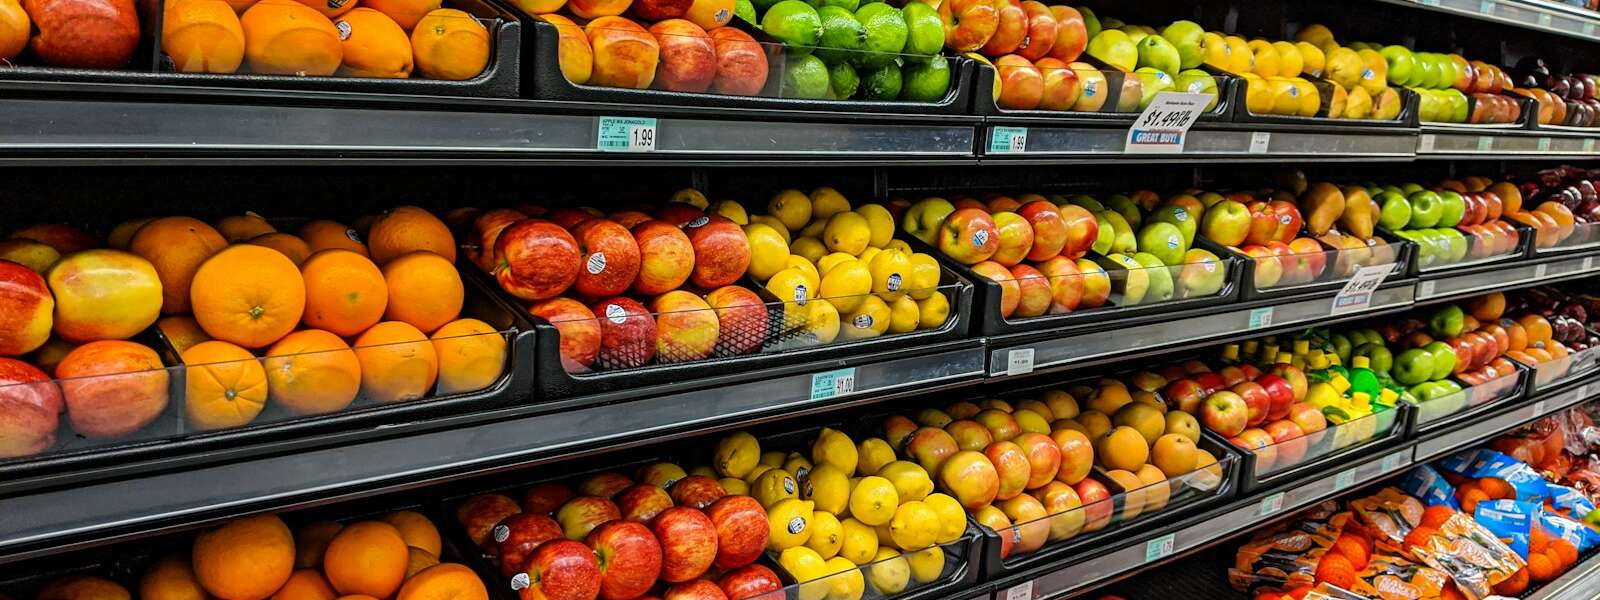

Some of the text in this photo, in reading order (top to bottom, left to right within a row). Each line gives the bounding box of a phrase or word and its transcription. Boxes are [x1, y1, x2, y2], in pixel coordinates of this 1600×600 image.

[634, 128, 653, 147] 1.99
[1013, 135, 1024, 150] 1.99
[1136, 132, 1177, 143] GREAT BUY!
